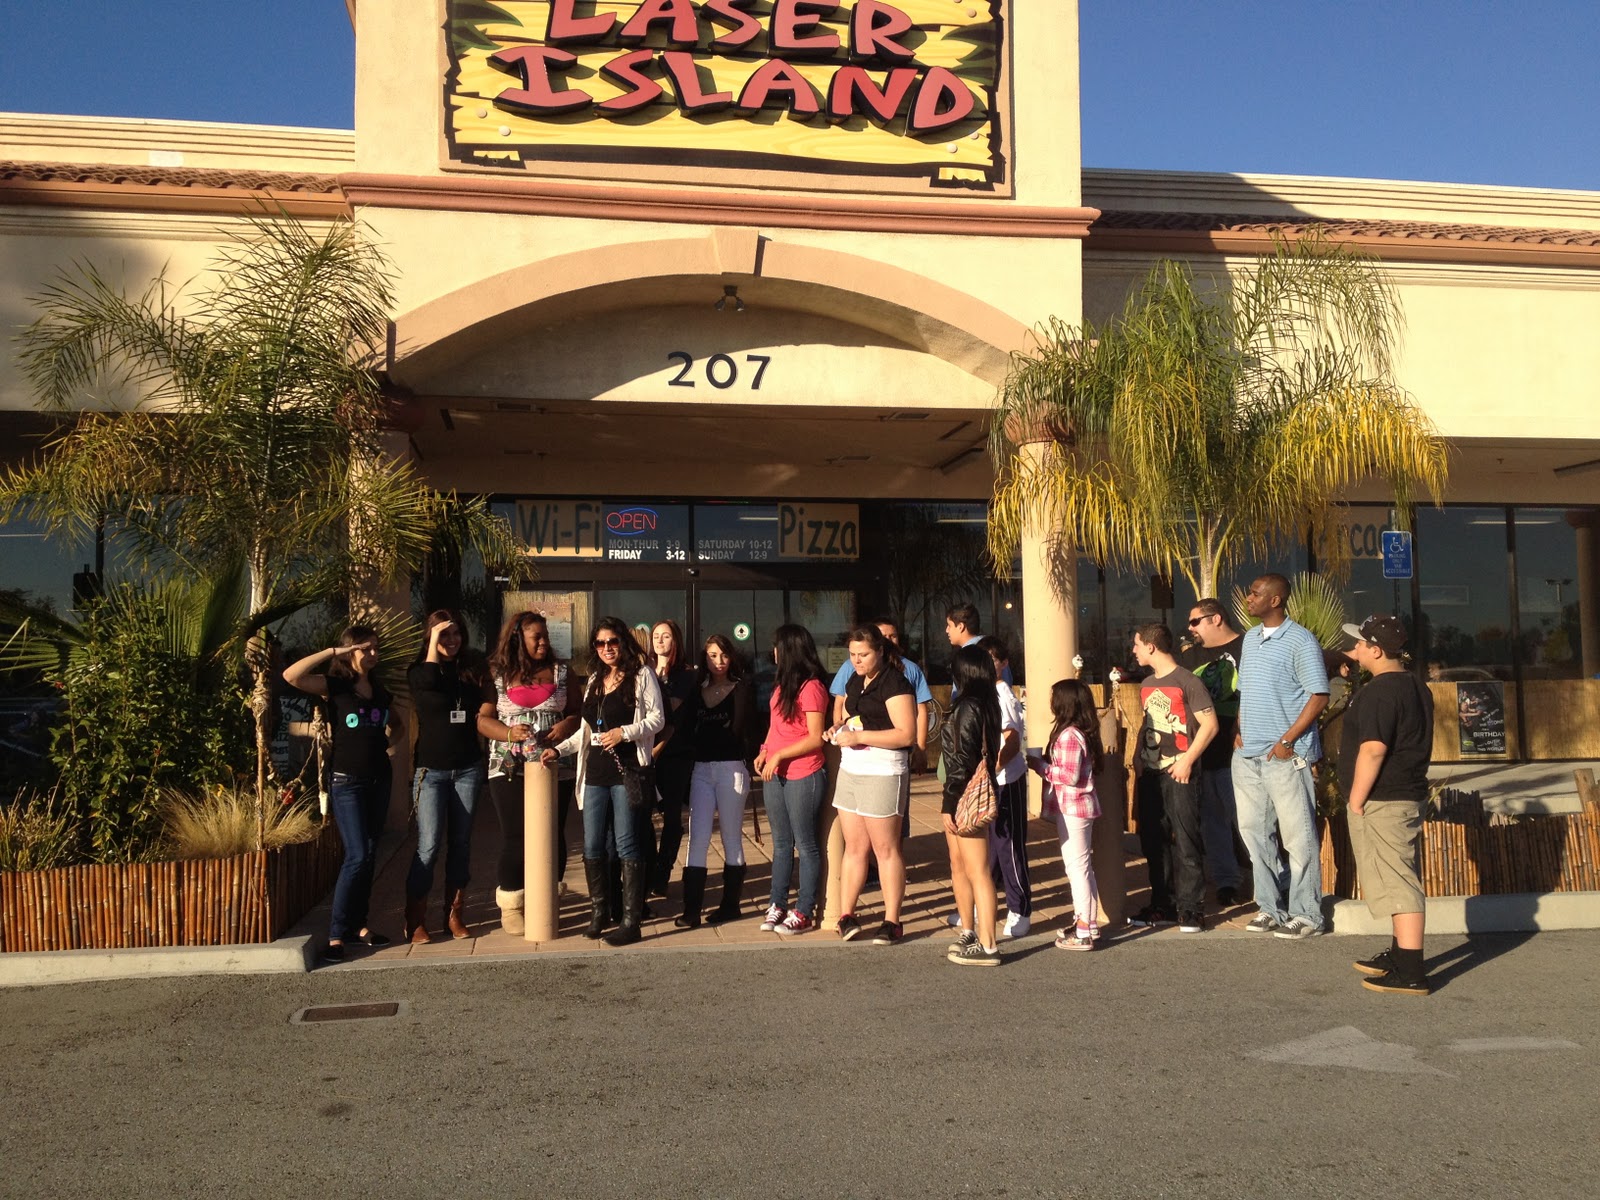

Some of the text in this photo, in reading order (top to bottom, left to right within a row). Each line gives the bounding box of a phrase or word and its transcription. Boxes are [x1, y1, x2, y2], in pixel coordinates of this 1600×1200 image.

[545, 0, 918, 61] LASER
[486, 45, 976, 136] ISLAND
[667, 351, 771, 389] 207
[519, 503, 600, 554] Wi-Fi
[606, 511, 657, 530] OPEN
[780, 505, 858, 555] Pizza
[608, 549, 686, 560] FRIDAY 3-12
[666, 540, 681, 549] 3-9
[698, 540, 772, 549] SATURDAY 10-12
[698, 550, 768, 560] SUNDAY 12-9
